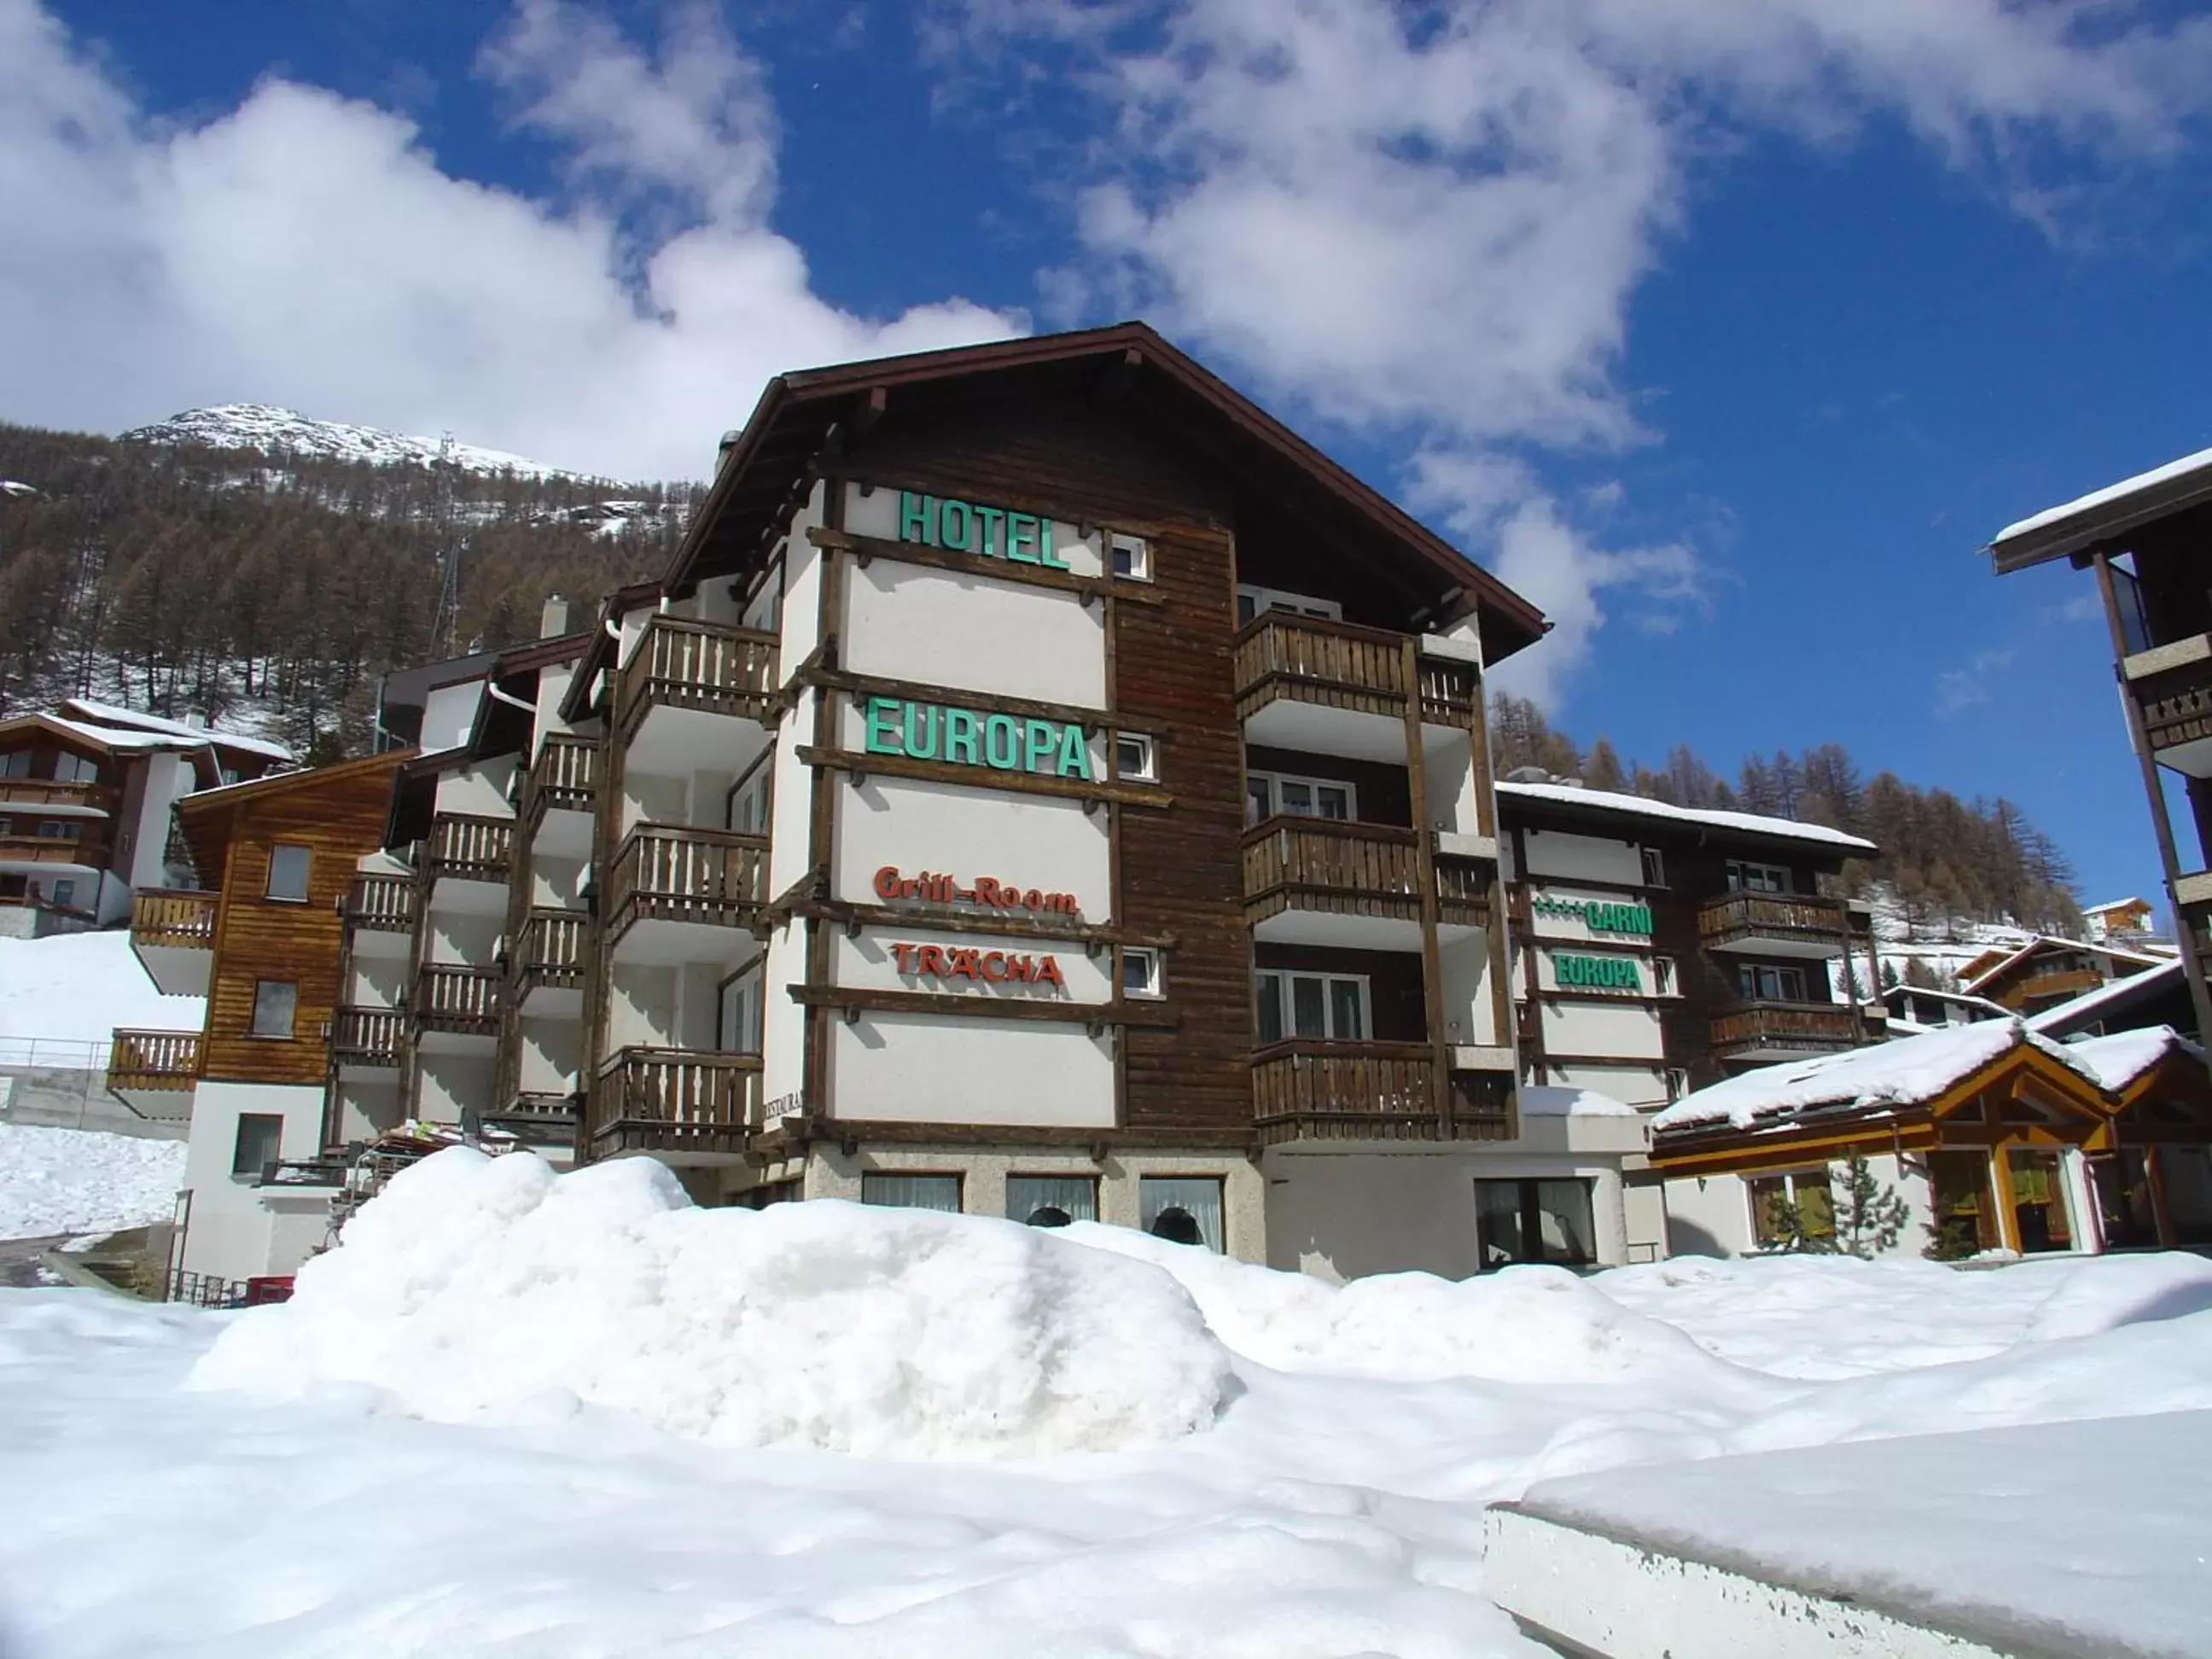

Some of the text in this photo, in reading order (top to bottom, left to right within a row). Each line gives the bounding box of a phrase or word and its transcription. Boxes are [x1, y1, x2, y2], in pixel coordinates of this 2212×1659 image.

[899, 490, 1070, 571] HOTEL
[865, 696, 1091, 780] EUROPA
[873, 865, 1080, 916] Grill-Room
[1585, 901, 1653, 934] GARNI
[889, 942, 1063, 987] TRÄCHA
[1552, 954, 1640, 988] EUROPA
